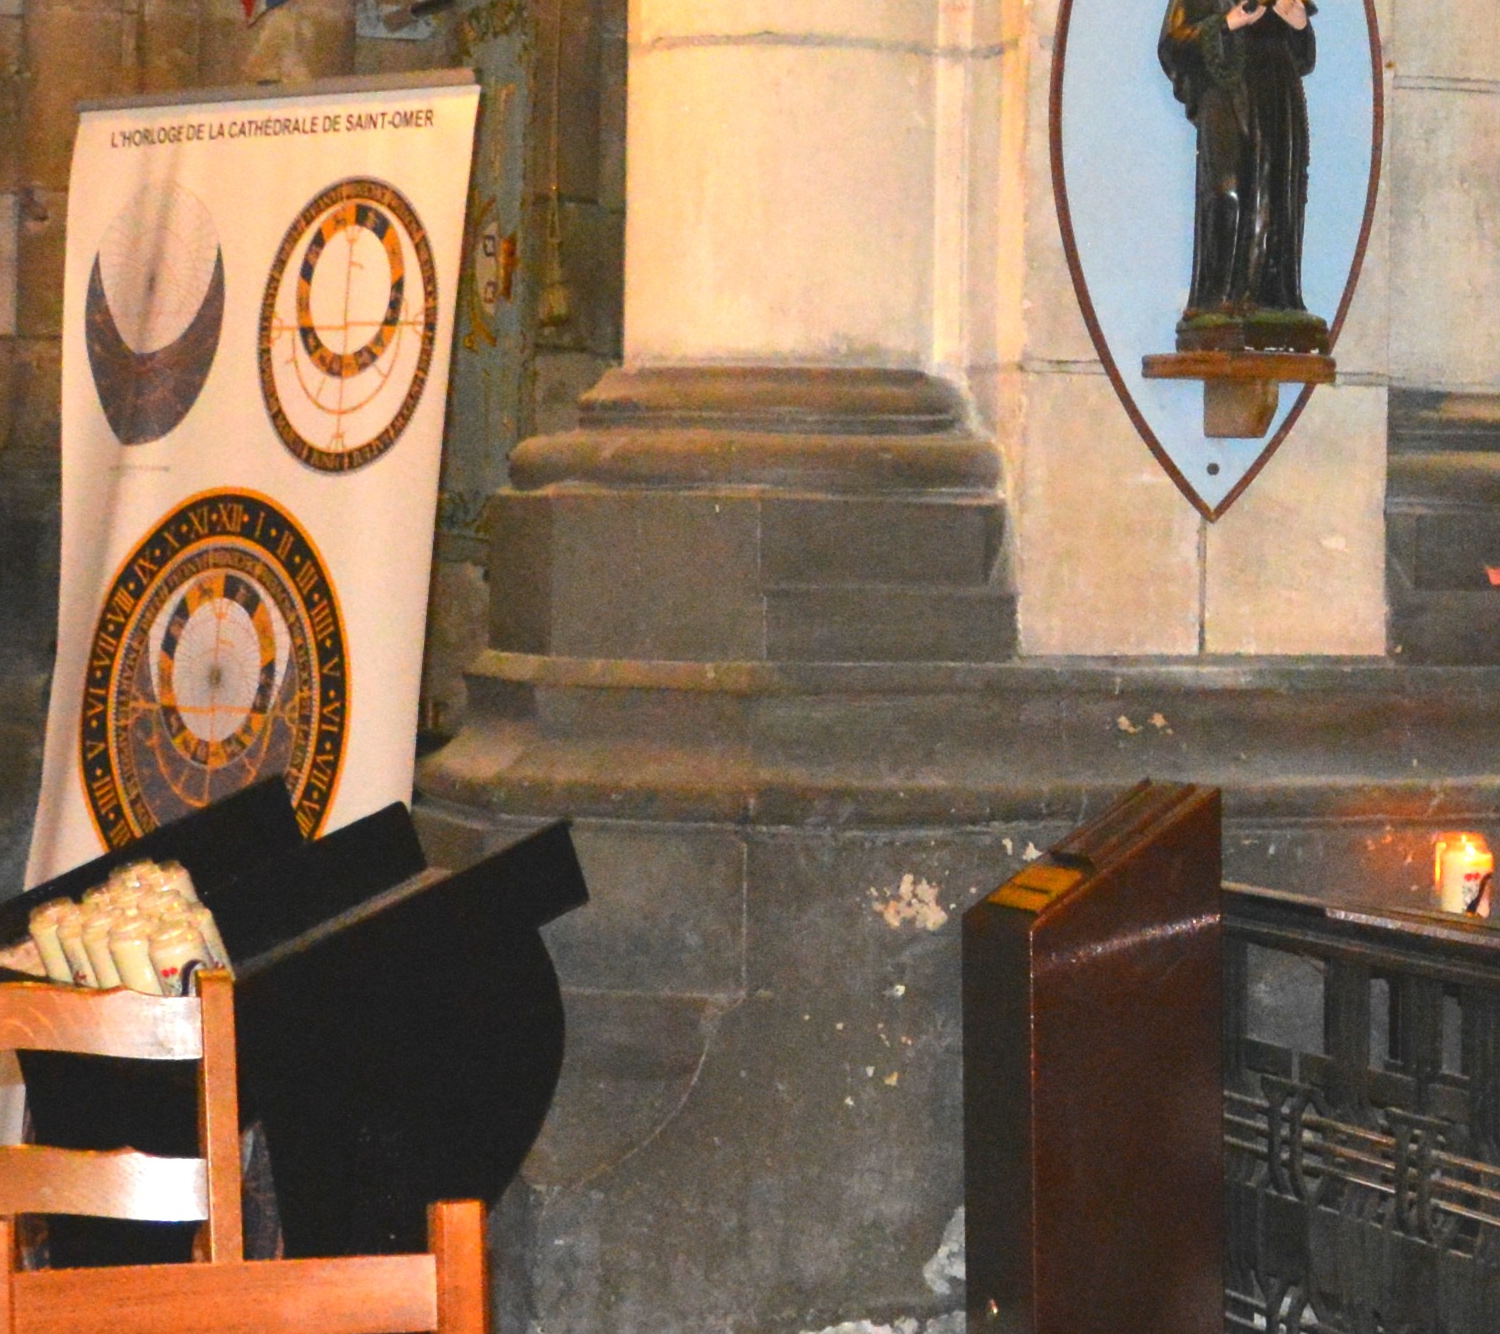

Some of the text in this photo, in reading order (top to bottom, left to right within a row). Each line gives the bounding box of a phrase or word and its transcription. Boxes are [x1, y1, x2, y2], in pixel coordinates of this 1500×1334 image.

[111, 109, 434, 148] L'HORLOGE DE LA CATHÉDRALE DE SAINT-OMER
